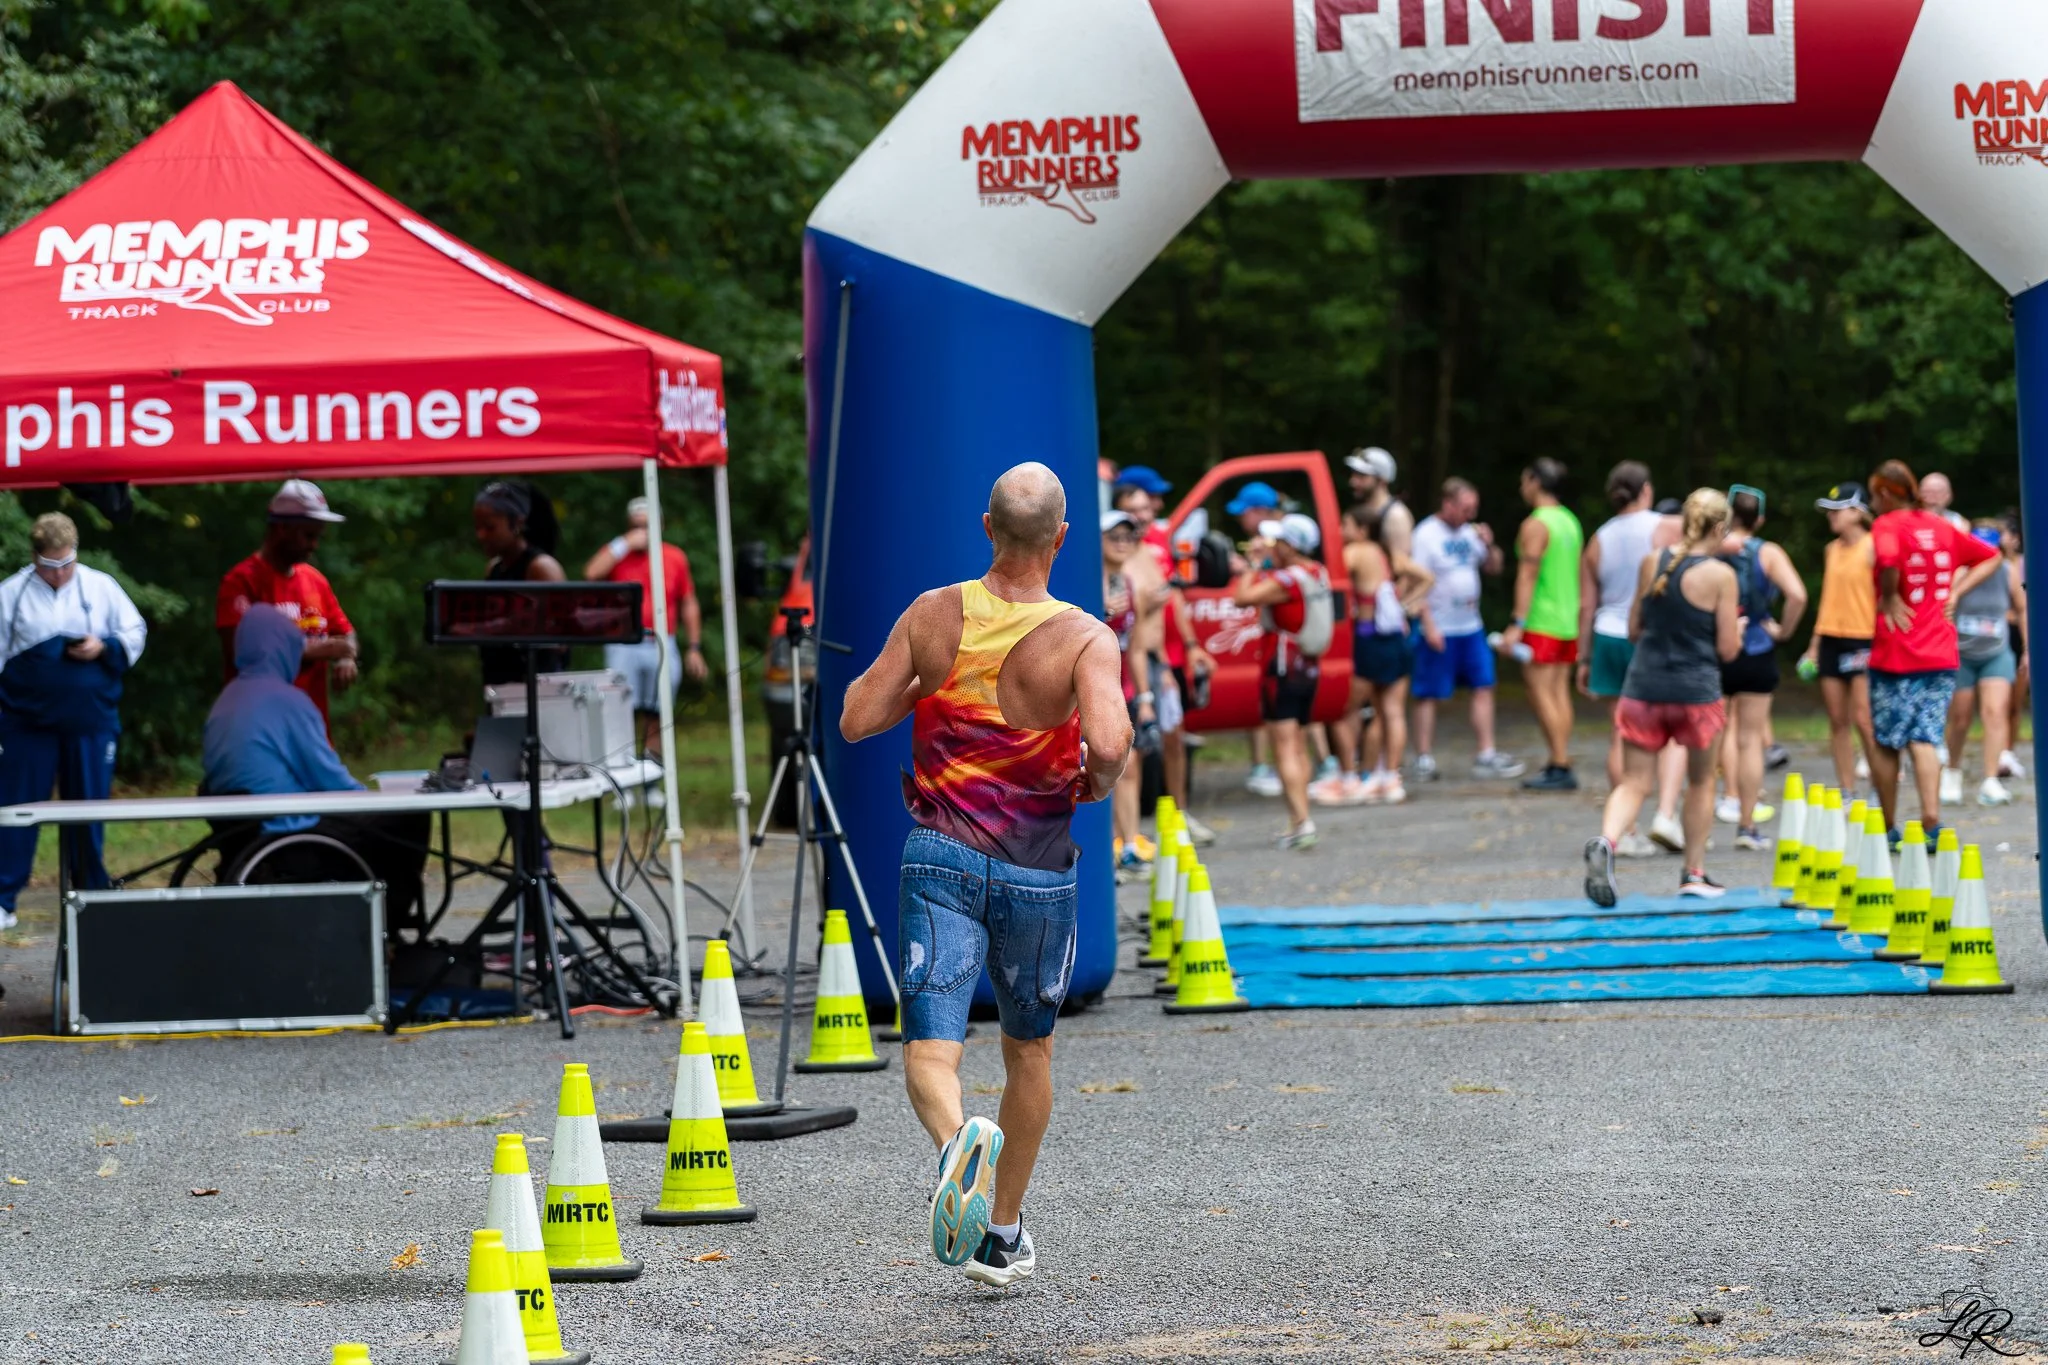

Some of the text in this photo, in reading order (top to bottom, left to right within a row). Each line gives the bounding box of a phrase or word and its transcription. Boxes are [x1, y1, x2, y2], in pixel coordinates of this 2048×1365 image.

[1393, 61, 1699, 92] memphisrunners.com
[961, 115, 1141, 160] MEMPHIS
[1977, 155, 2026, 166] TRACK
[977, 155, 1120, 188] RUNNERS
[979, 189, 1121, 207] TRACK CLUB
[34, 218, 370, 266] MEMPHIS
[60, 257, 326, 300] RUNNERS
[67, 299, 331, 320] TRACK CLUB
[203, 380, 541, 444] Runners
[1951, 940, 1994, 954] MRTC
[1186, 959, 1227, 974] MRTC
[818, 1013, 863, 1028] MRTC
[711, 1053, 740, 1070] TC
[670, 1150, 727, 1170] MRTC
[547, 1202, 609, 1223] MRTC
